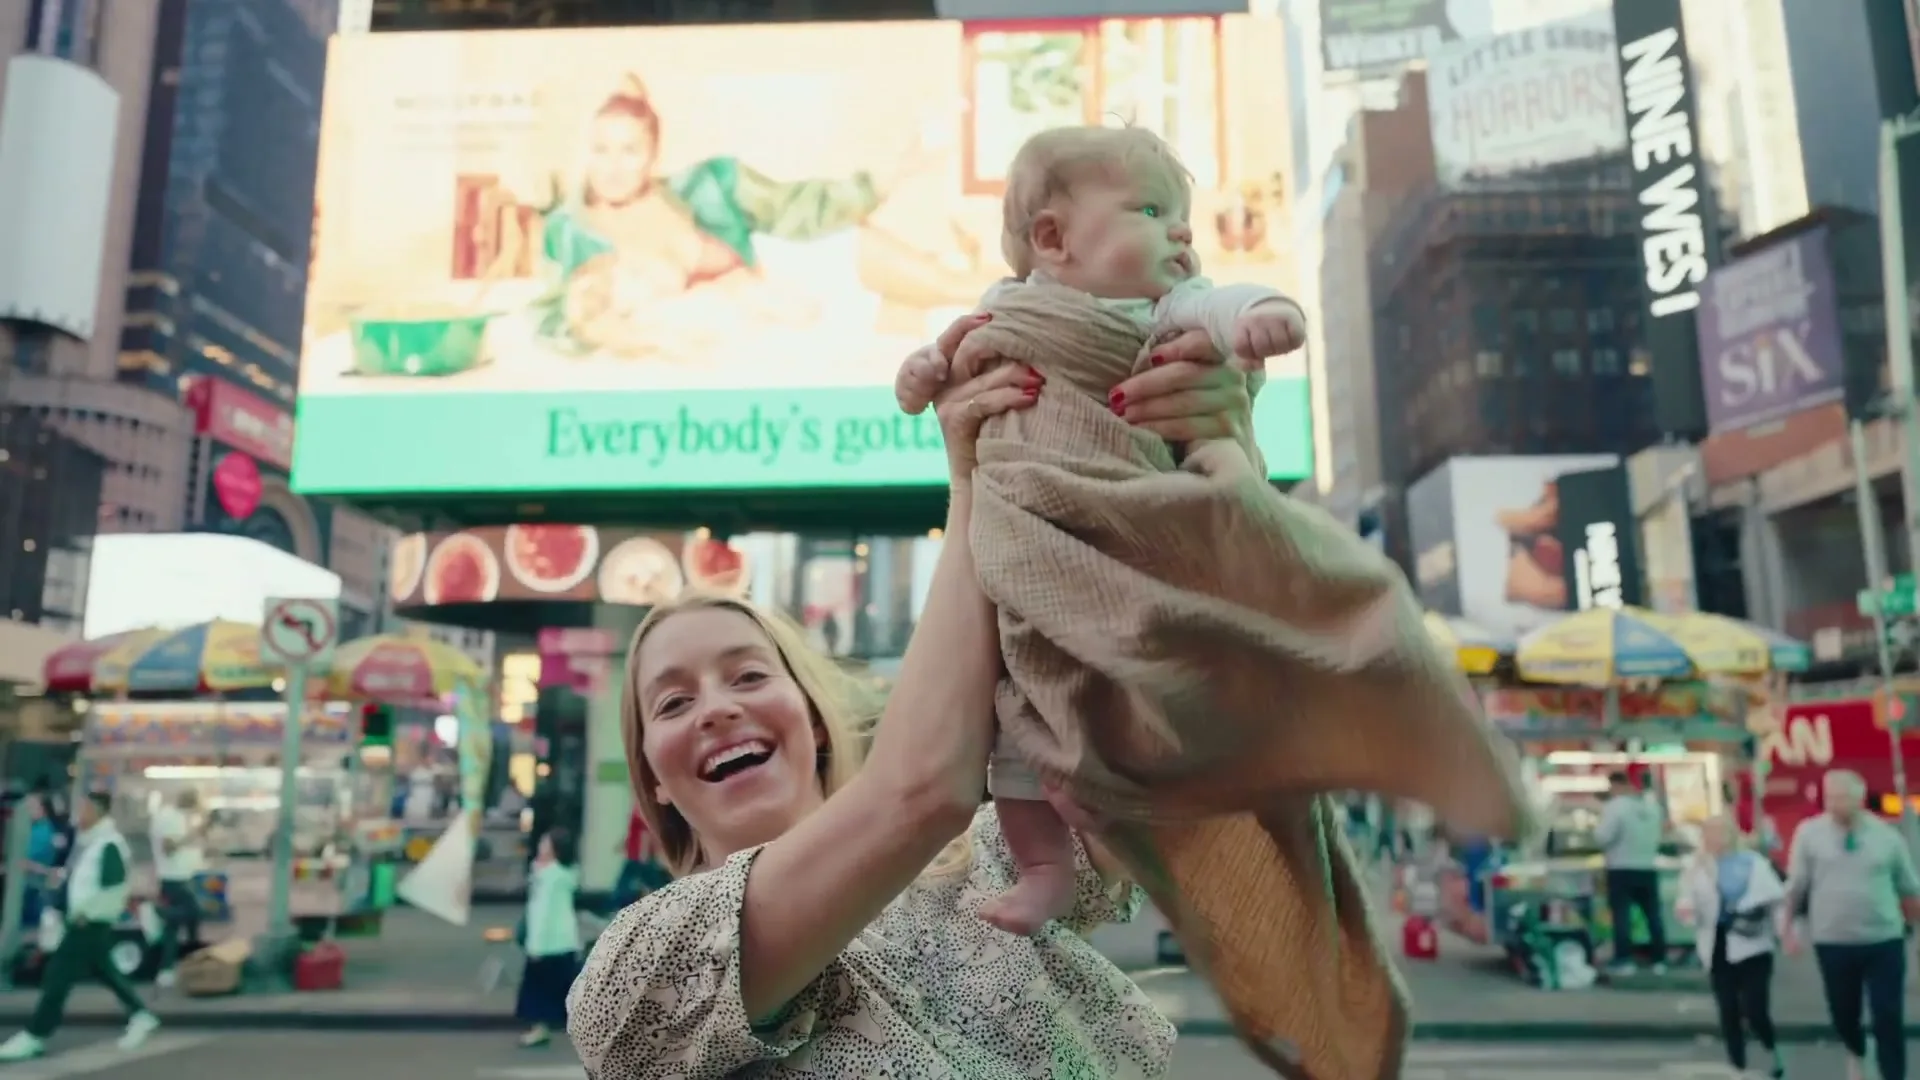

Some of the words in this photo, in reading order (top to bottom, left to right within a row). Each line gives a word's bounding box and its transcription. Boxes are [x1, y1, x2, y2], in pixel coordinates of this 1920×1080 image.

[1450, 63, 1617, 143] HORRORS
[1621, 27, 1692, 172] NINE
[1719, 320, 1826, 407] SIX
[546, 404, 821, 467] Everybody's
